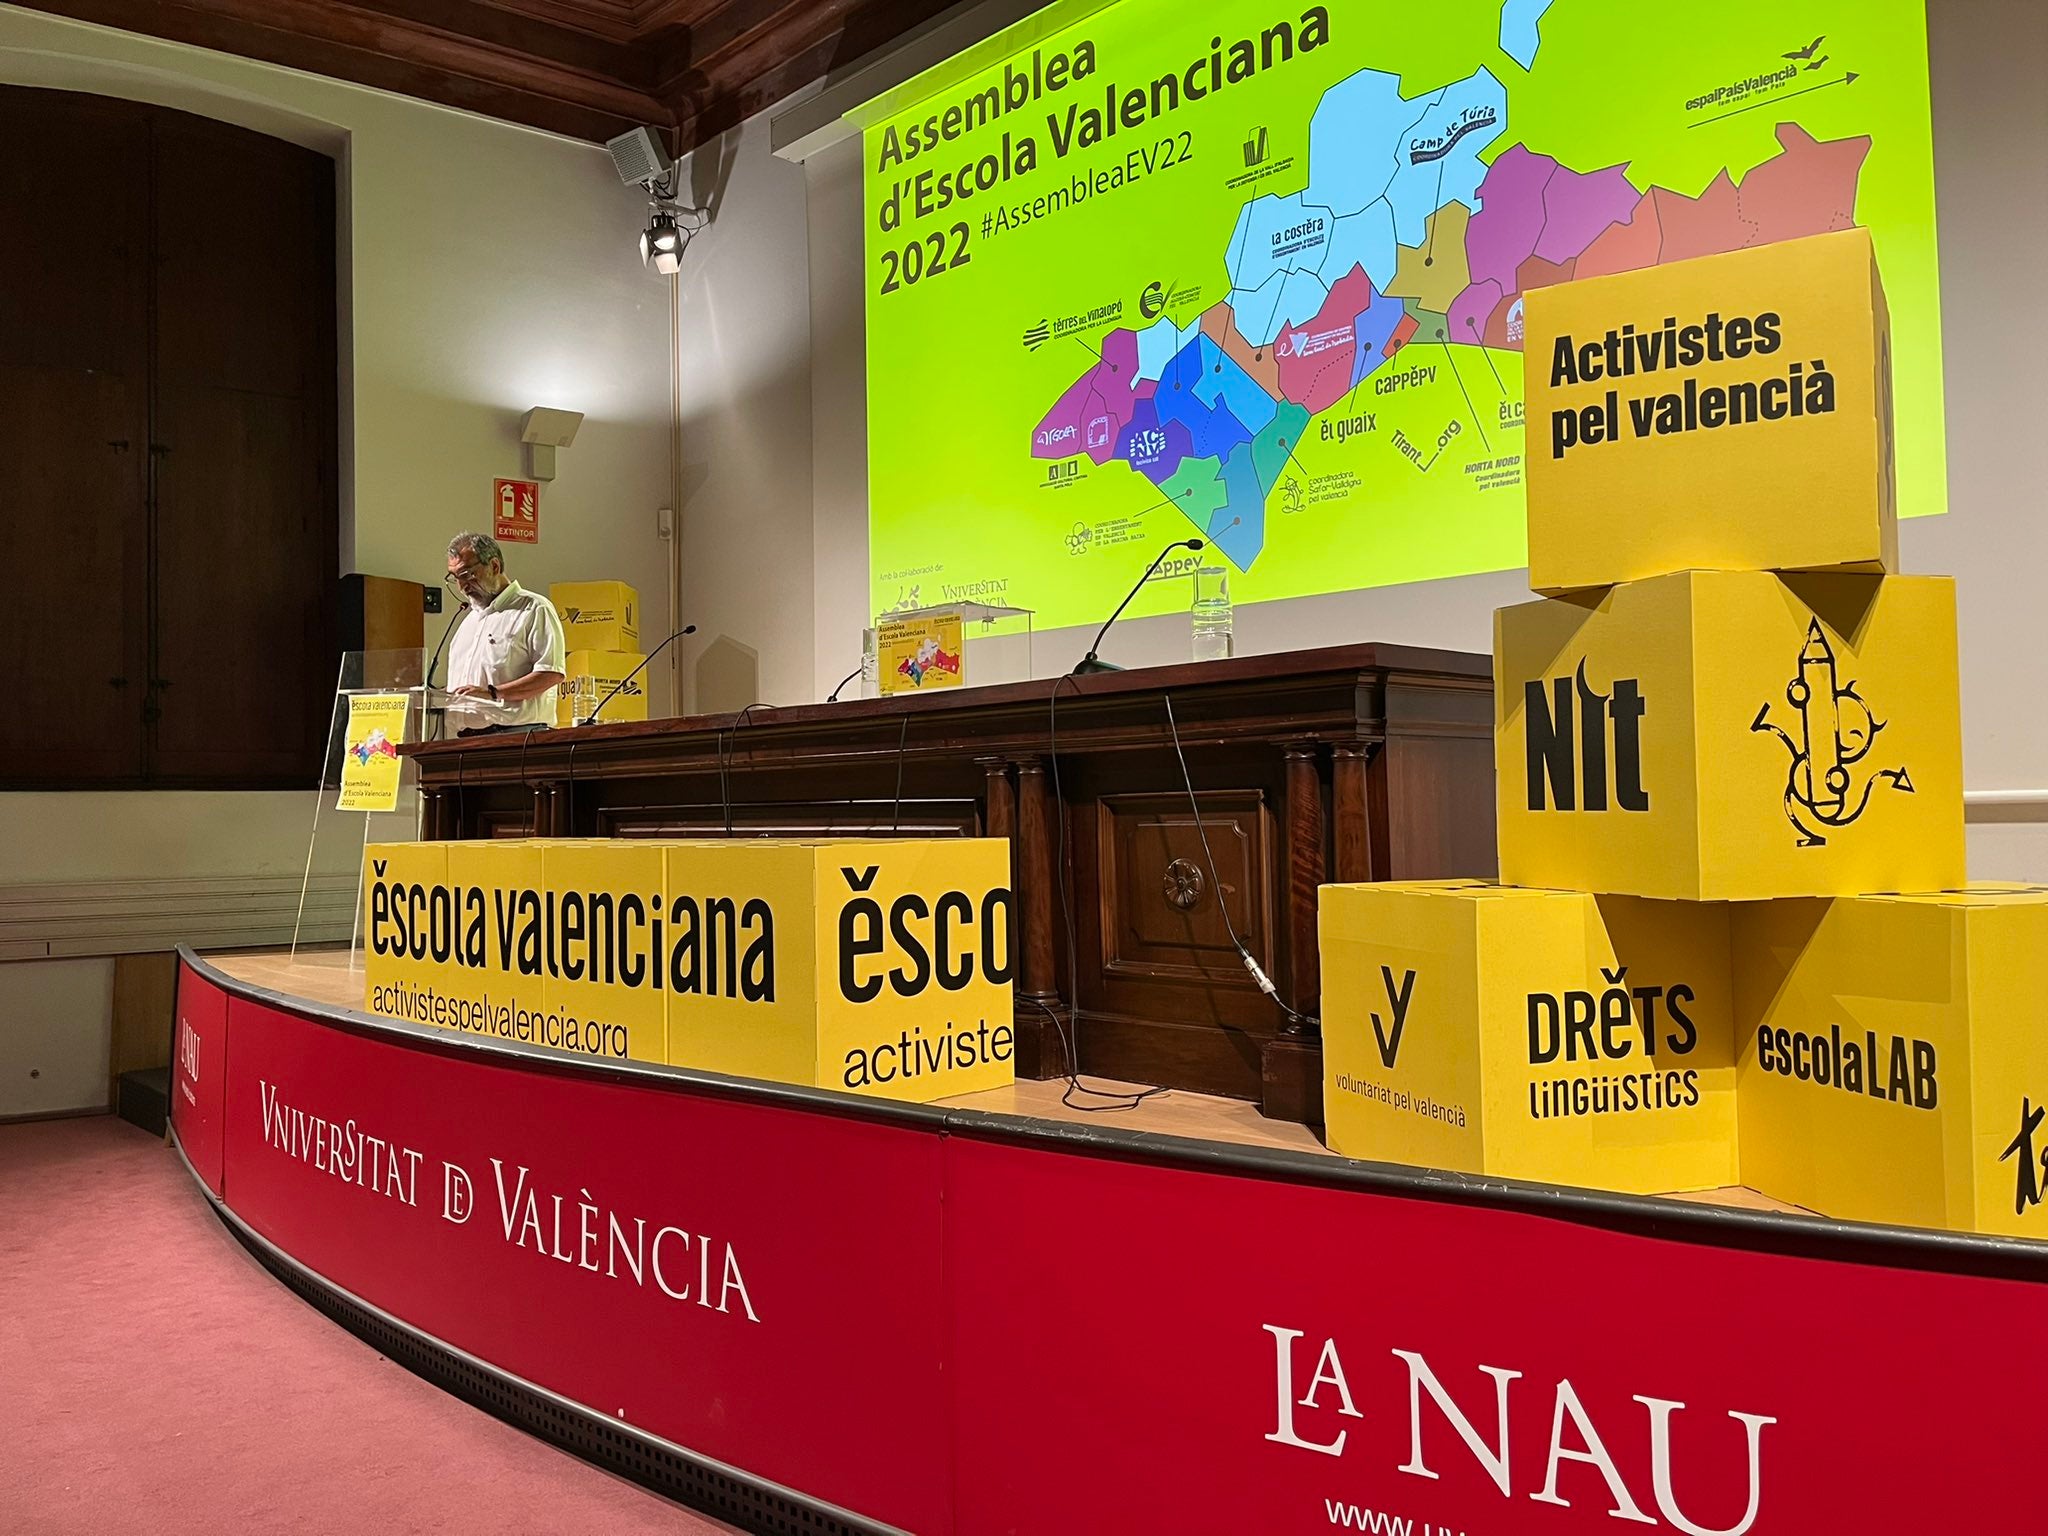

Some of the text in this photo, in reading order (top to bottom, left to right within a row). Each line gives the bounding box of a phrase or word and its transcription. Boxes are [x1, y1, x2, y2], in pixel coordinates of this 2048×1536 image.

[878, 40, 1096, 173] Assemblea
[1046, 5, 1330, 158] Valenciana
[1686, 64, 1797, 110] espaiPaísValencià
[1410, 106, 1495, 151] Camp de Túria
[981, 131, 1193, 239] #AssembleaEV22
[880, 222, 972, 295] 2022
[1272, 232, 1281, 246] la
[1550, 312, 1781, 388] Activistes
[1337, 412, 1376, 444] guaix
[1551, 359, 1836, 460] pel valencià
[1391, 429, 1422, 463] Tirant
[1465, 455, 1520, 474] HORTA NORD
[498, 527, 535, 538] EXTINTOR
[879, 623, 905, 633] Assemblea
[899, 629, 926, 640] Valenciana
[372, 699, 406, 711] valenciana
[341, 799, 355, 807] 2022
[344, 779, 371, 788] Assemblea
[364, 789, 392, 798] Valenciana
[494, 888, 776, 1003] valenciana
[373, 980, 629, 1059] activistespelvalencia.org
[844, 1018, 1014, 1088] activiste
[1757, 1024, 1938, 1111] escolaLAB
[1335, 1071, 1466, 1128] voluntariat pel valencià
[259, 1079, 423, 1207] VNIVERSITAT
[1391, 1347, 1777, 1536] NAU
